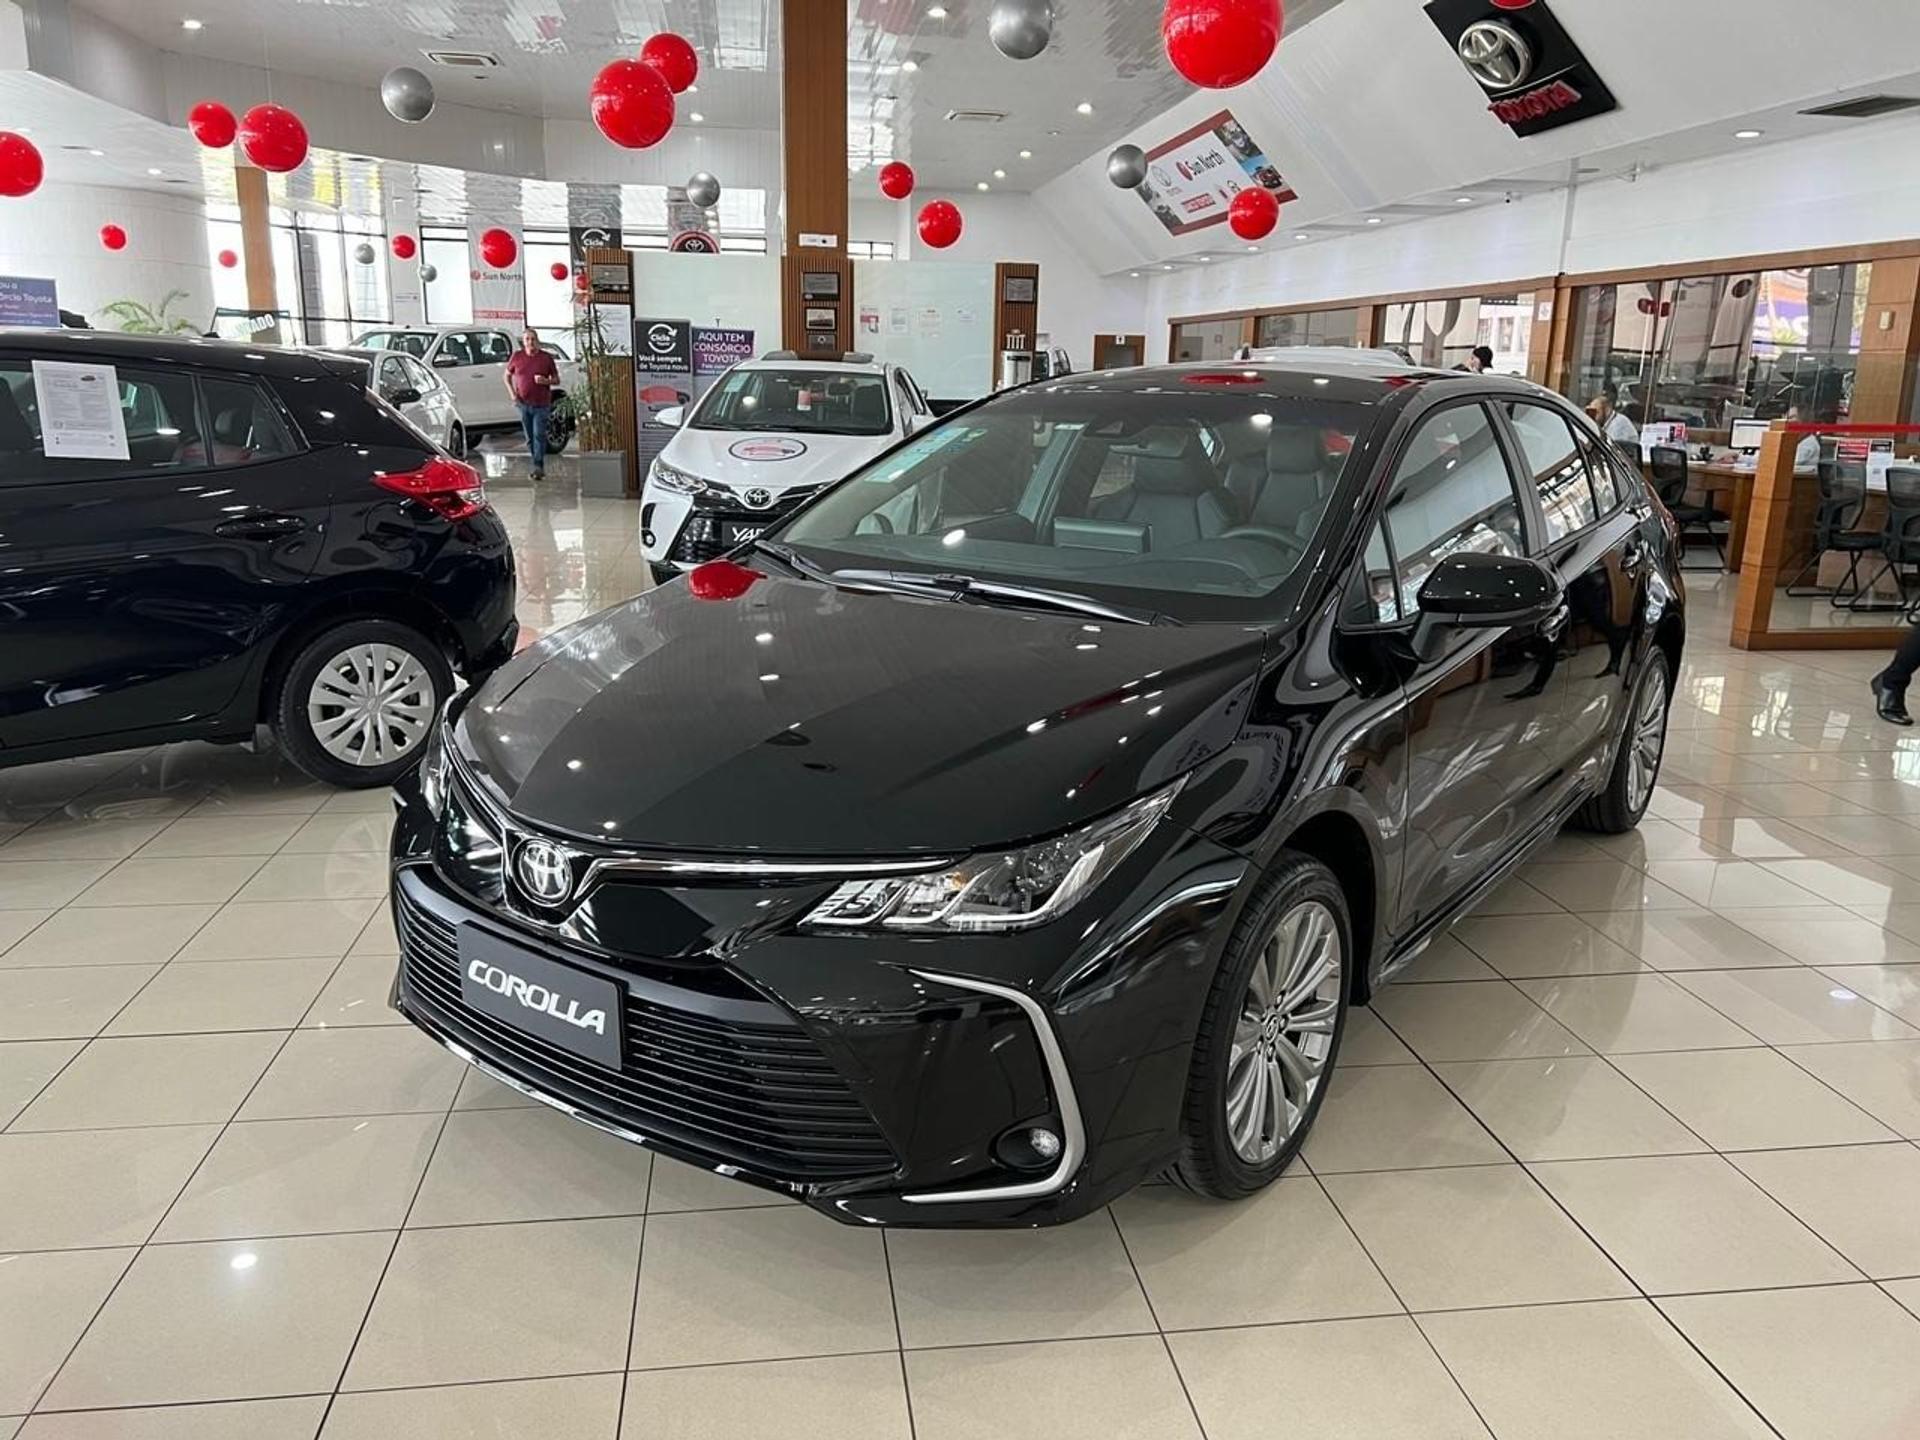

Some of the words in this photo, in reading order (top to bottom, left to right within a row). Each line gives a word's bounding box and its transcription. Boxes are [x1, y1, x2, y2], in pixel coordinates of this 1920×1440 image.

[1487, 79, 1582, 125] TOYOTA
[1185, 159, 1206, 177] Sun
[1197, 147, 1225, 171] North
[482, 271, 498, 281] Sun
[23, 292, 52, 304] Toyota
[650, 333, 671, 342] Ciclo
[698, 331, 723, 342] AQUI
[724, 333, 745, 342] TEM
[693, 341, 752, 354] CONSÓRCIO
[638, 354, 656, 362] Você
[657, 355, 682, 364] sempre
[703, 353, 740, 363] TOYOTA
[639, 362, 648, 370] de
[649, 362, 671, 371] Toyota
[468, 959, 606, 1035] COROLLA
